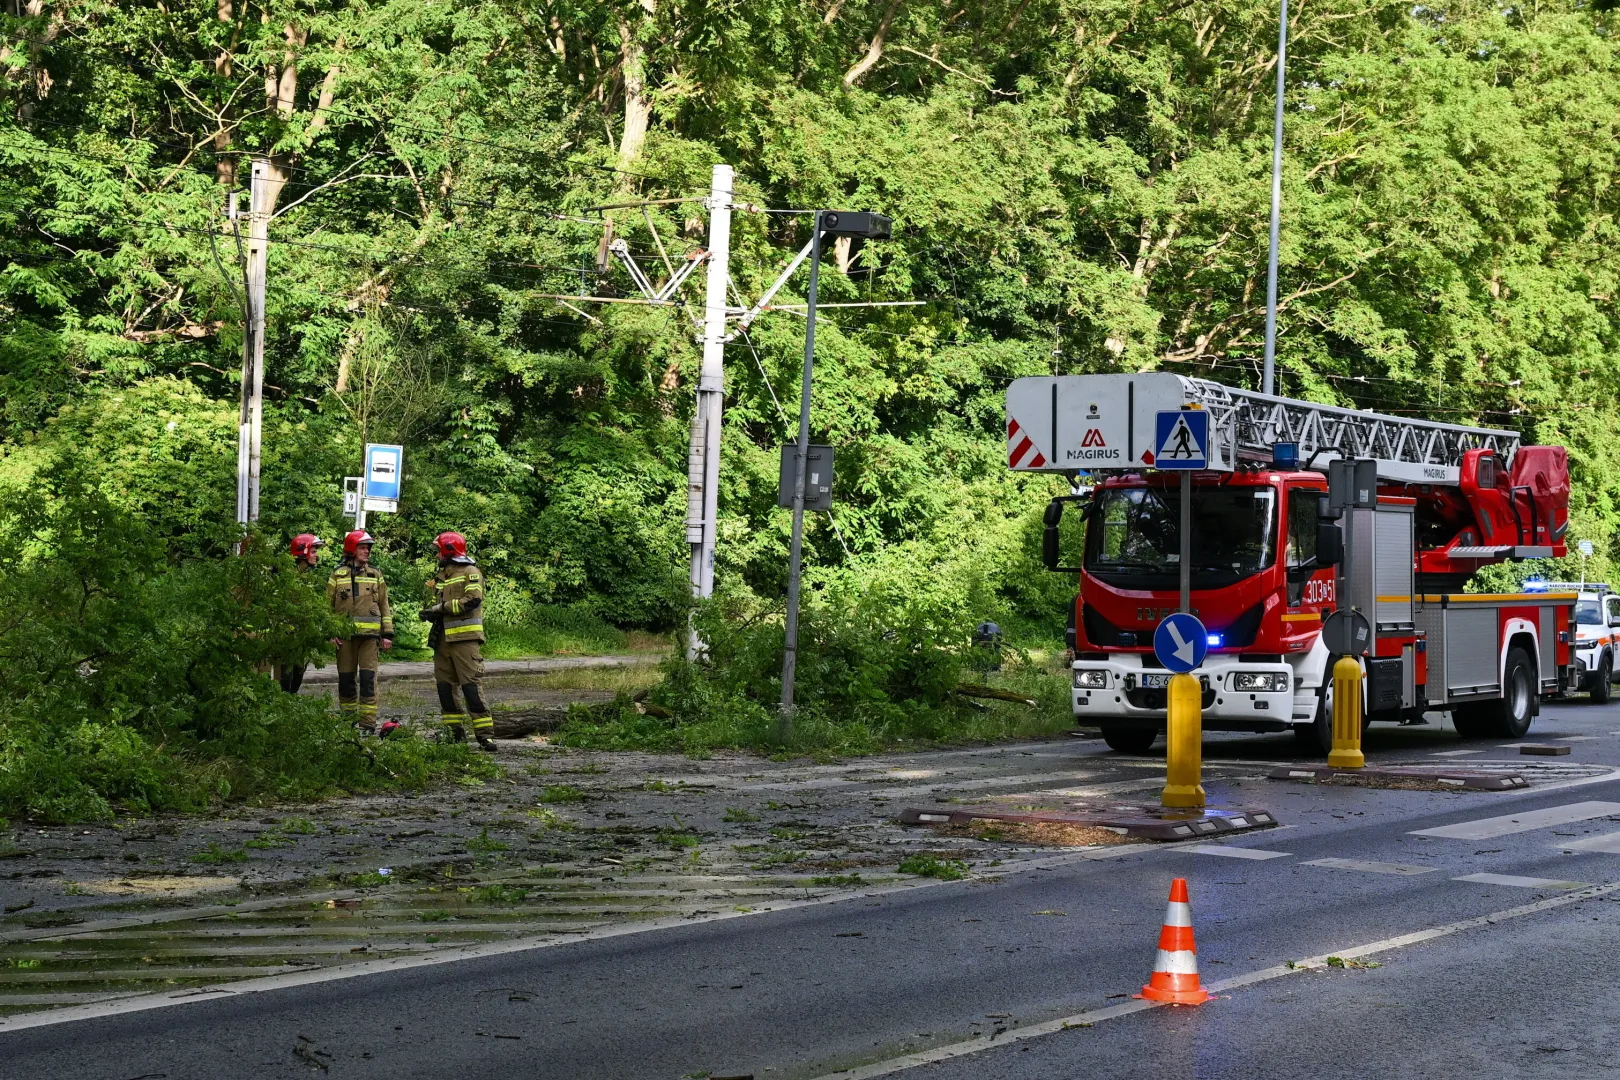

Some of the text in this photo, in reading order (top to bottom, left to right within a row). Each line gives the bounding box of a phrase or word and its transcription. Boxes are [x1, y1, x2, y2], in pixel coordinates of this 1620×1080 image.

[1066, 448, 1120, 460] MAGIRUS
[1423, 467, 1446, 480] MAGIRUS
[1148, 675, 1161, 686] ZS
